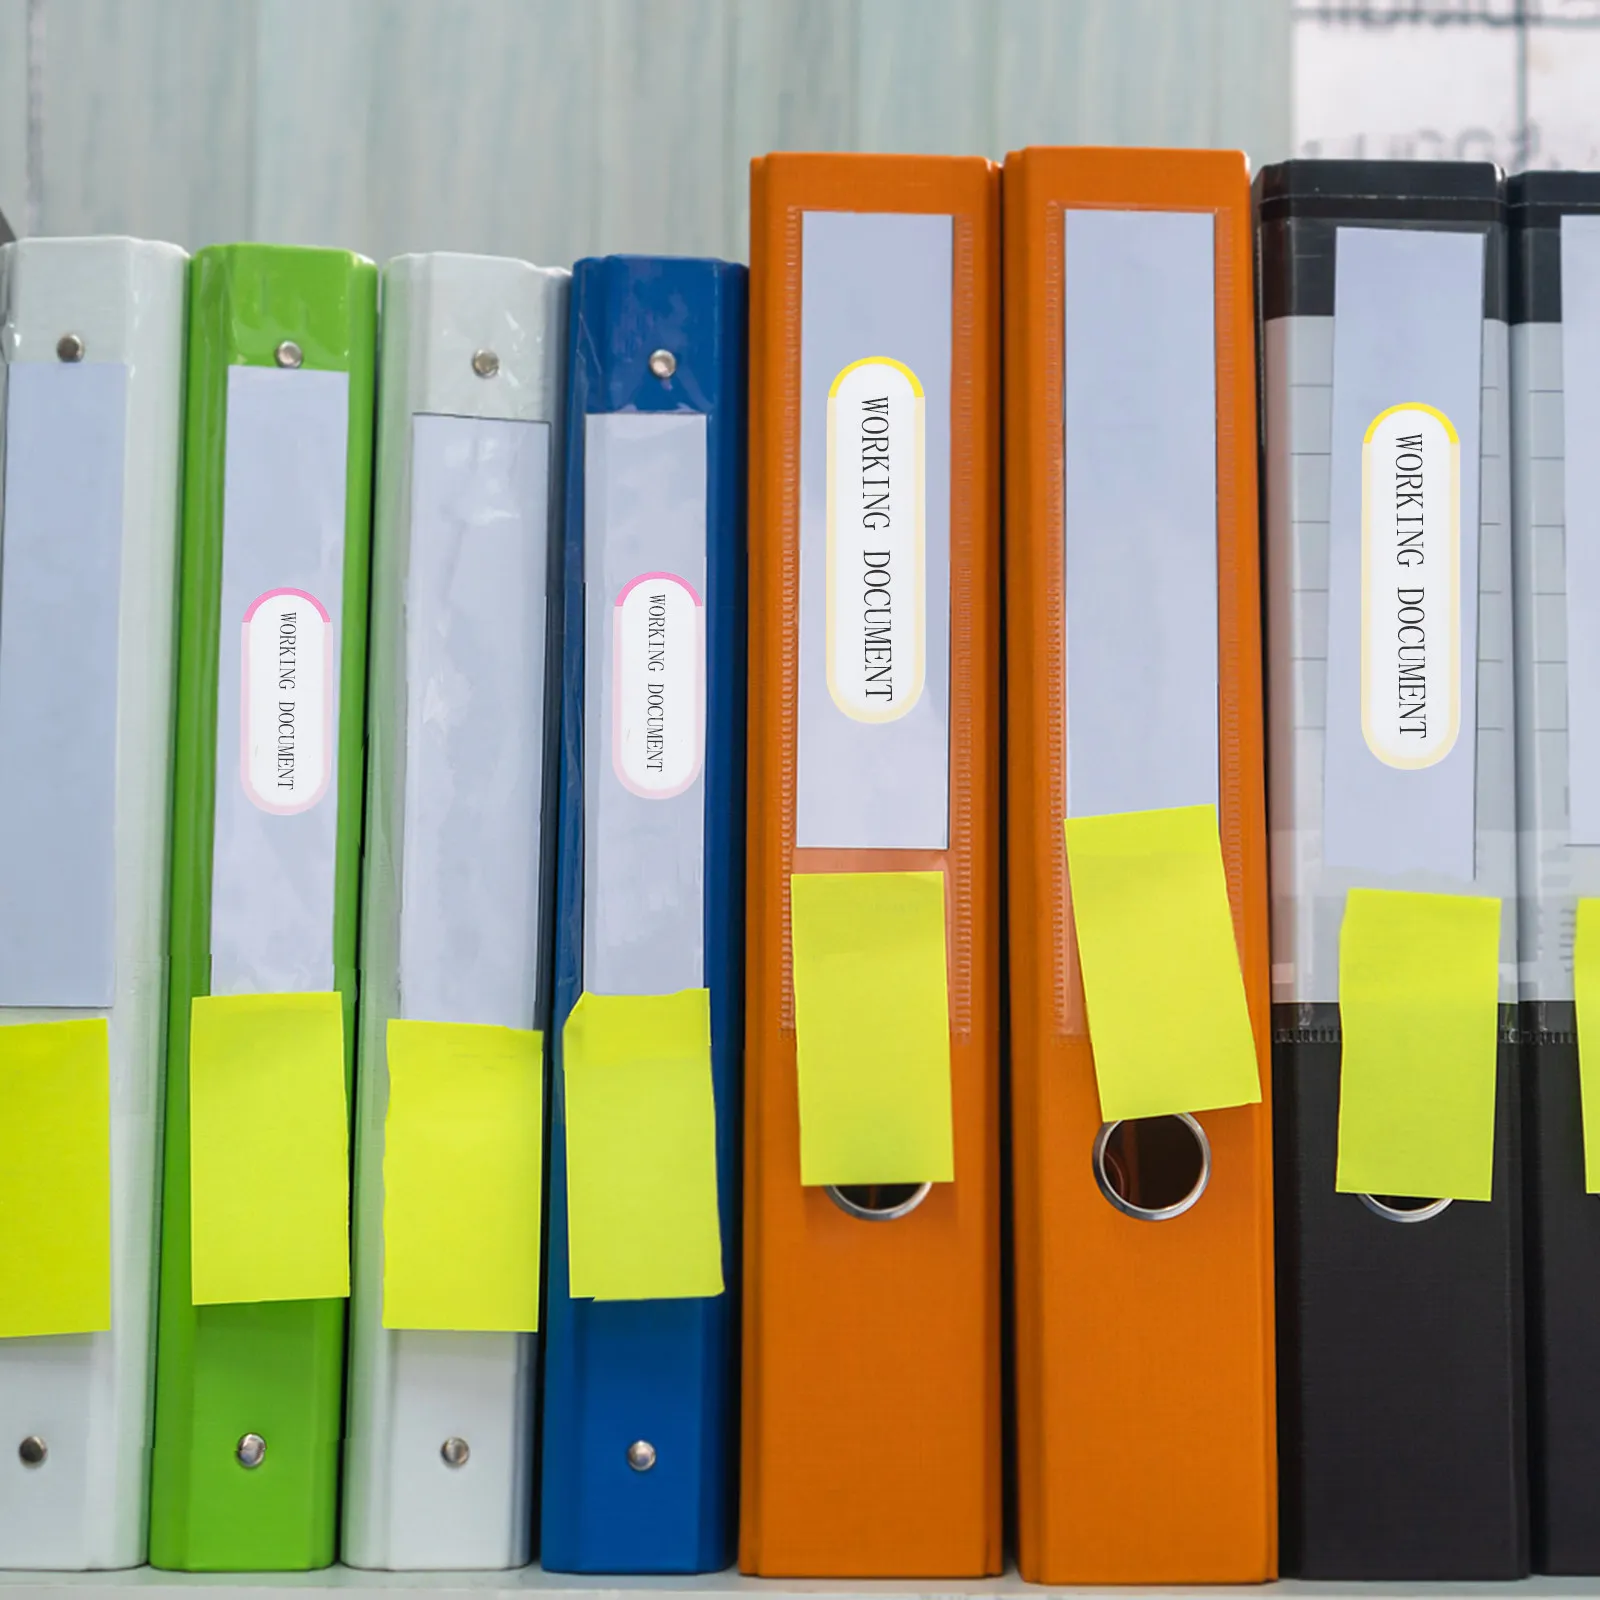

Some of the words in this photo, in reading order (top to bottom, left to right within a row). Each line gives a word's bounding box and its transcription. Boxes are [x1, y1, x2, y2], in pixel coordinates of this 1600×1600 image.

[861, 396, 890, 530] WORKING
[1396, 433, 1425, 567] WORKING
[279, 612, 296, 690] WORKING
[648, 594, 665, 672] WORKING
[863, 550, 892, 702] DOCUMENT
[1397, 587, 1426, 739] DOCUMENT
[278, 701, 295, 790] DOCUMENT
[647, 683, 664, 772] DOCUMENT
